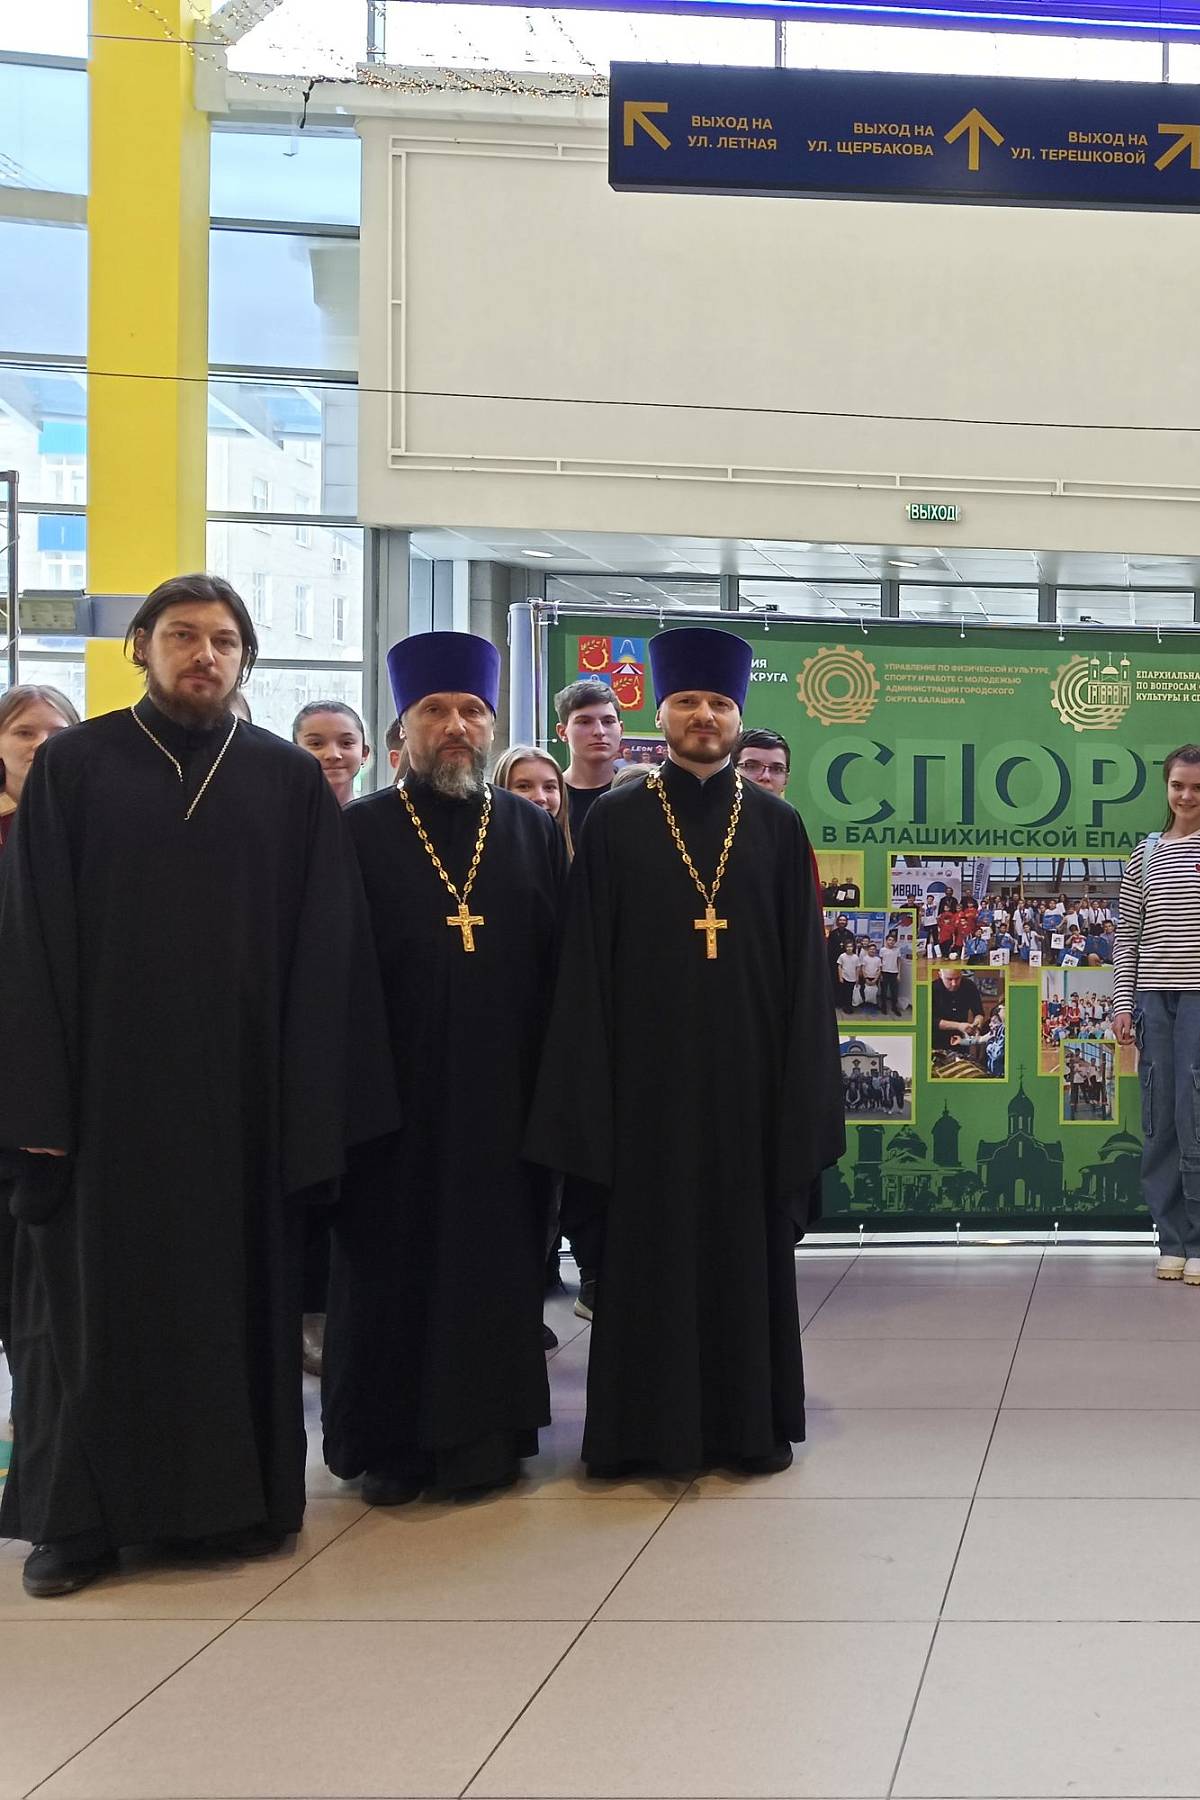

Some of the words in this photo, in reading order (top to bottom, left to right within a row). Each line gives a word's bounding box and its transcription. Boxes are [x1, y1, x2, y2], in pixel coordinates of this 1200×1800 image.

[691, 115, 749, 131] ВЫХОД
[752, 118, 773, 130] НА
[853, 122, 911, 137] ВЫХОД
[914, 125, 935, 137] НА
[687, 136, 713, 148] УЛ.
[716, 137, 777, 150] ЛЕТНАЯ
[1068, 131, 1125, 146] ВЫХОД
[1128, 133, 1148, 146] НА
[807, 140, 832, 153] УЛ.
[837, 142, 935, 156] ЩЕРБАКОВА
[1010, 147, 1036, 160] УЛ.
[1040, 148, 1147, 164] ТЕРЕШКОВОЙ
[911, 504, 956, 520] ВЫХОД
[884, 663, 937, 671] УПРАВЛЕНИЕ
[938, 664, 950, 672] ПО
[951, 664, 1006, 673] ФИЗИЧЕСКОЙ
[750, 672, 788, 682] КРУГА
[884, 674, 916, 682] СПОРТУ
[925, 675, 956, 683] РАБОТЕ
[965, 676, 1022, 685] МОЛОДЕЖЬЮ
[886, 684, 960, 694] АДМИНИСТРАЦИИ
[961, 687, 1015, 696] ГОРОДСКОГО
[1136, 682, 1149, 690] ПО
[1150, 683, 1197, 691] ВОПРОСАМ
[885, 695, 917, 703] ОКРУГА
[918, 696, 966, 704] БАЛАШИХА
[1136, 692, 1181, 702] КУЛЬТУРЫ
[1183, 694, 1190, 702] И
[808, 735, 1164, 829] СПОР
[822, 826, 838, 843] В
[845, 825, 1078, 848] БАЛАШИХИНСКОЙ
